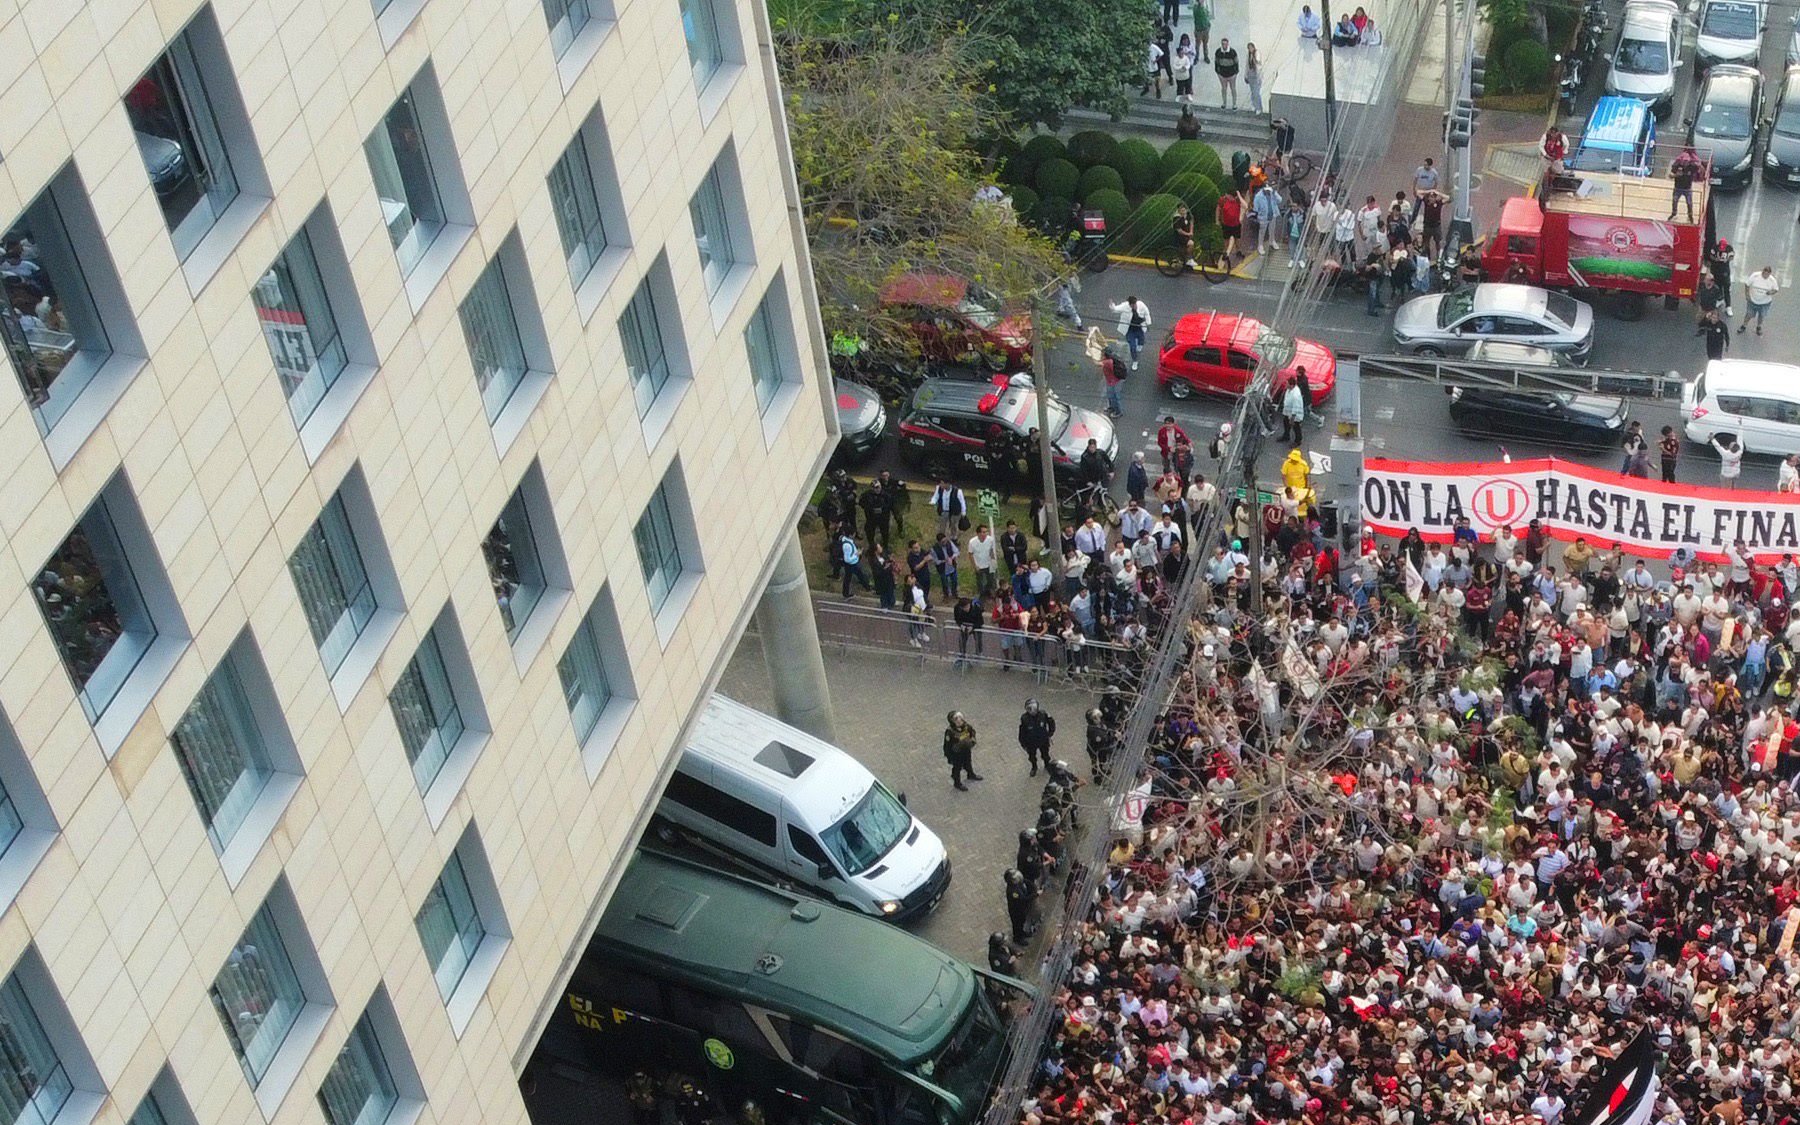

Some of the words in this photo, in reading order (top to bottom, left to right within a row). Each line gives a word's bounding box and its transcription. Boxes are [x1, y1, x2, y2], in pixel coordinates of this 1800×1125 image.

[1421, 482, 1464, 526] LA
[1485, 488, 1516, 522] U
[1536, 478, 1652, 540] HASTA
[1660, 503, 1700, 543] EL
